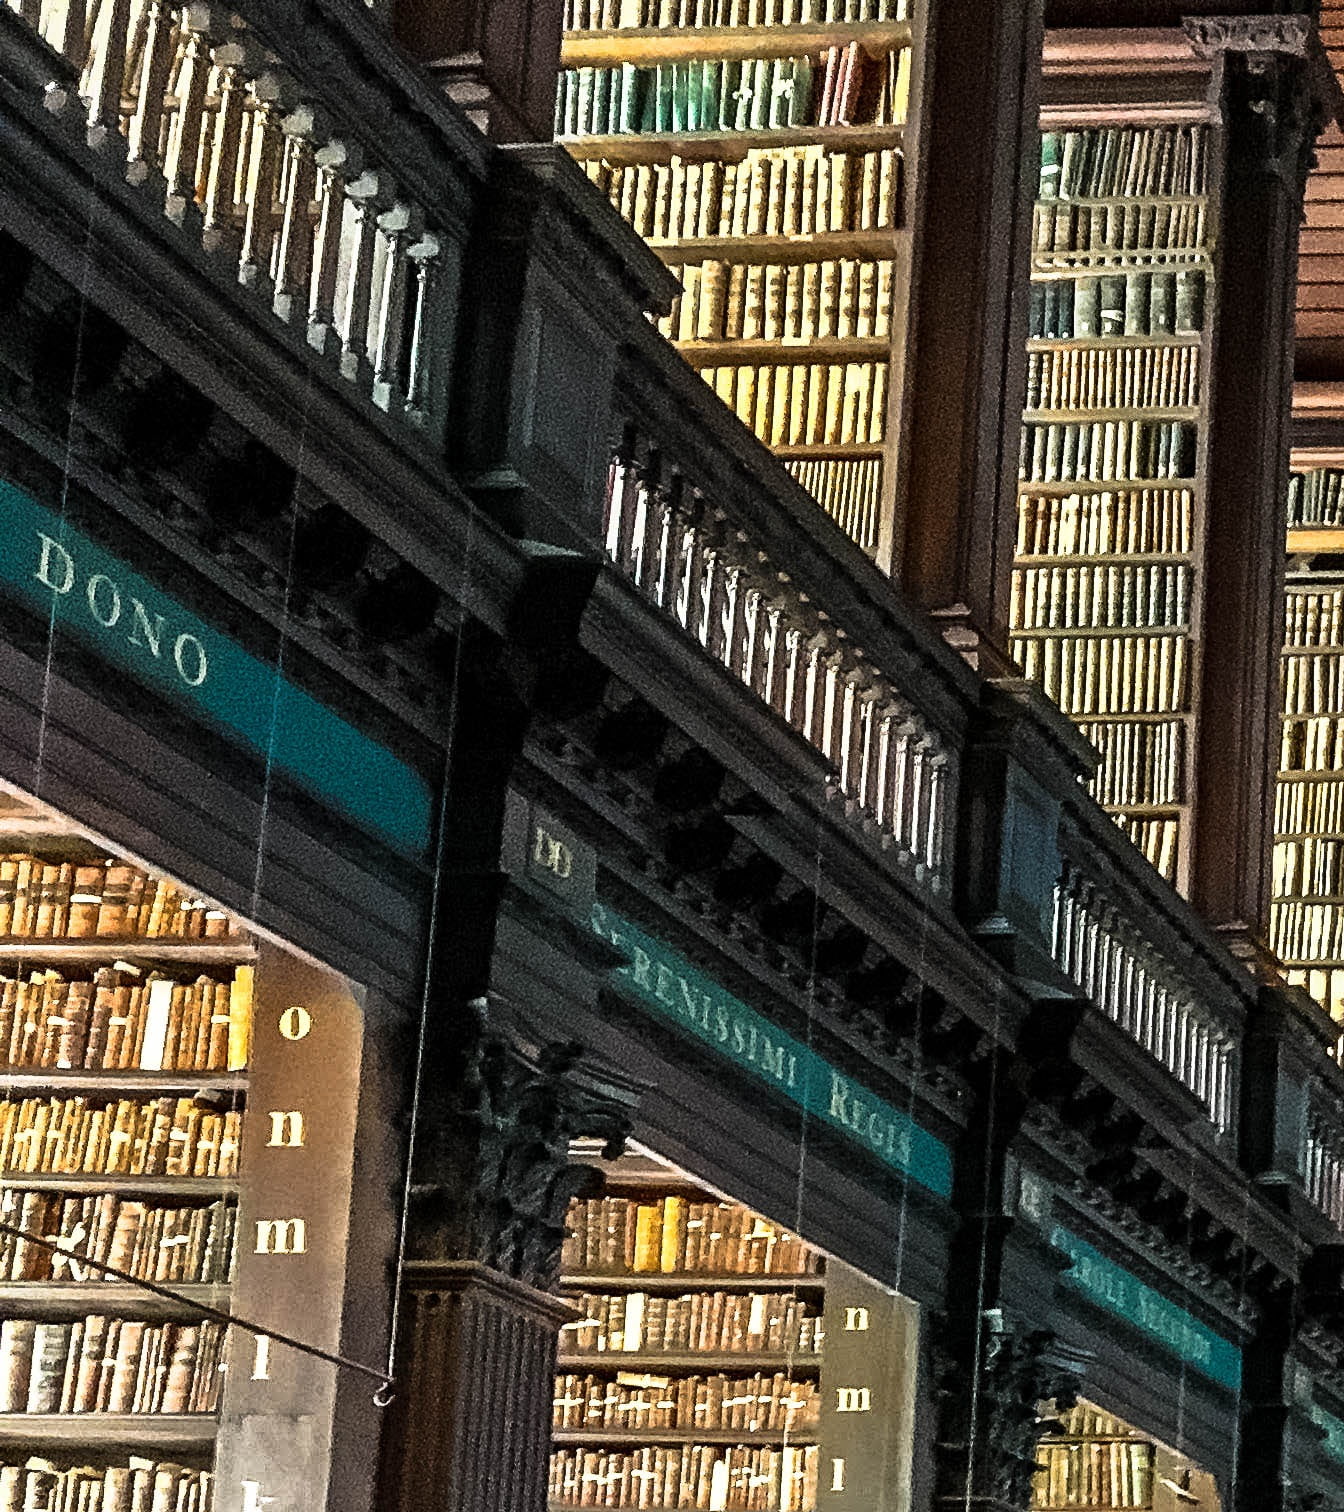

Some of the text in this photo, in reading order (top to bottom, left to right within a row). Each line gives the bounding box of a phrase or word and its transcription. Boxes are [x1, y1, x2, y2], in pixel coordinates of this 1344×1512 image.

[34, 532, 210, 687] DONO
[279, 1006, 312, 1040] o
[266, 1110, 304, 1147] n
[253, 1217, 306, 1254] m
[844, 1307, 869, 1331] n
[251, 1334, 270, 1380] l
[836, 1385, 871, 1412] m
[830, 1459, 846, 1491] l
